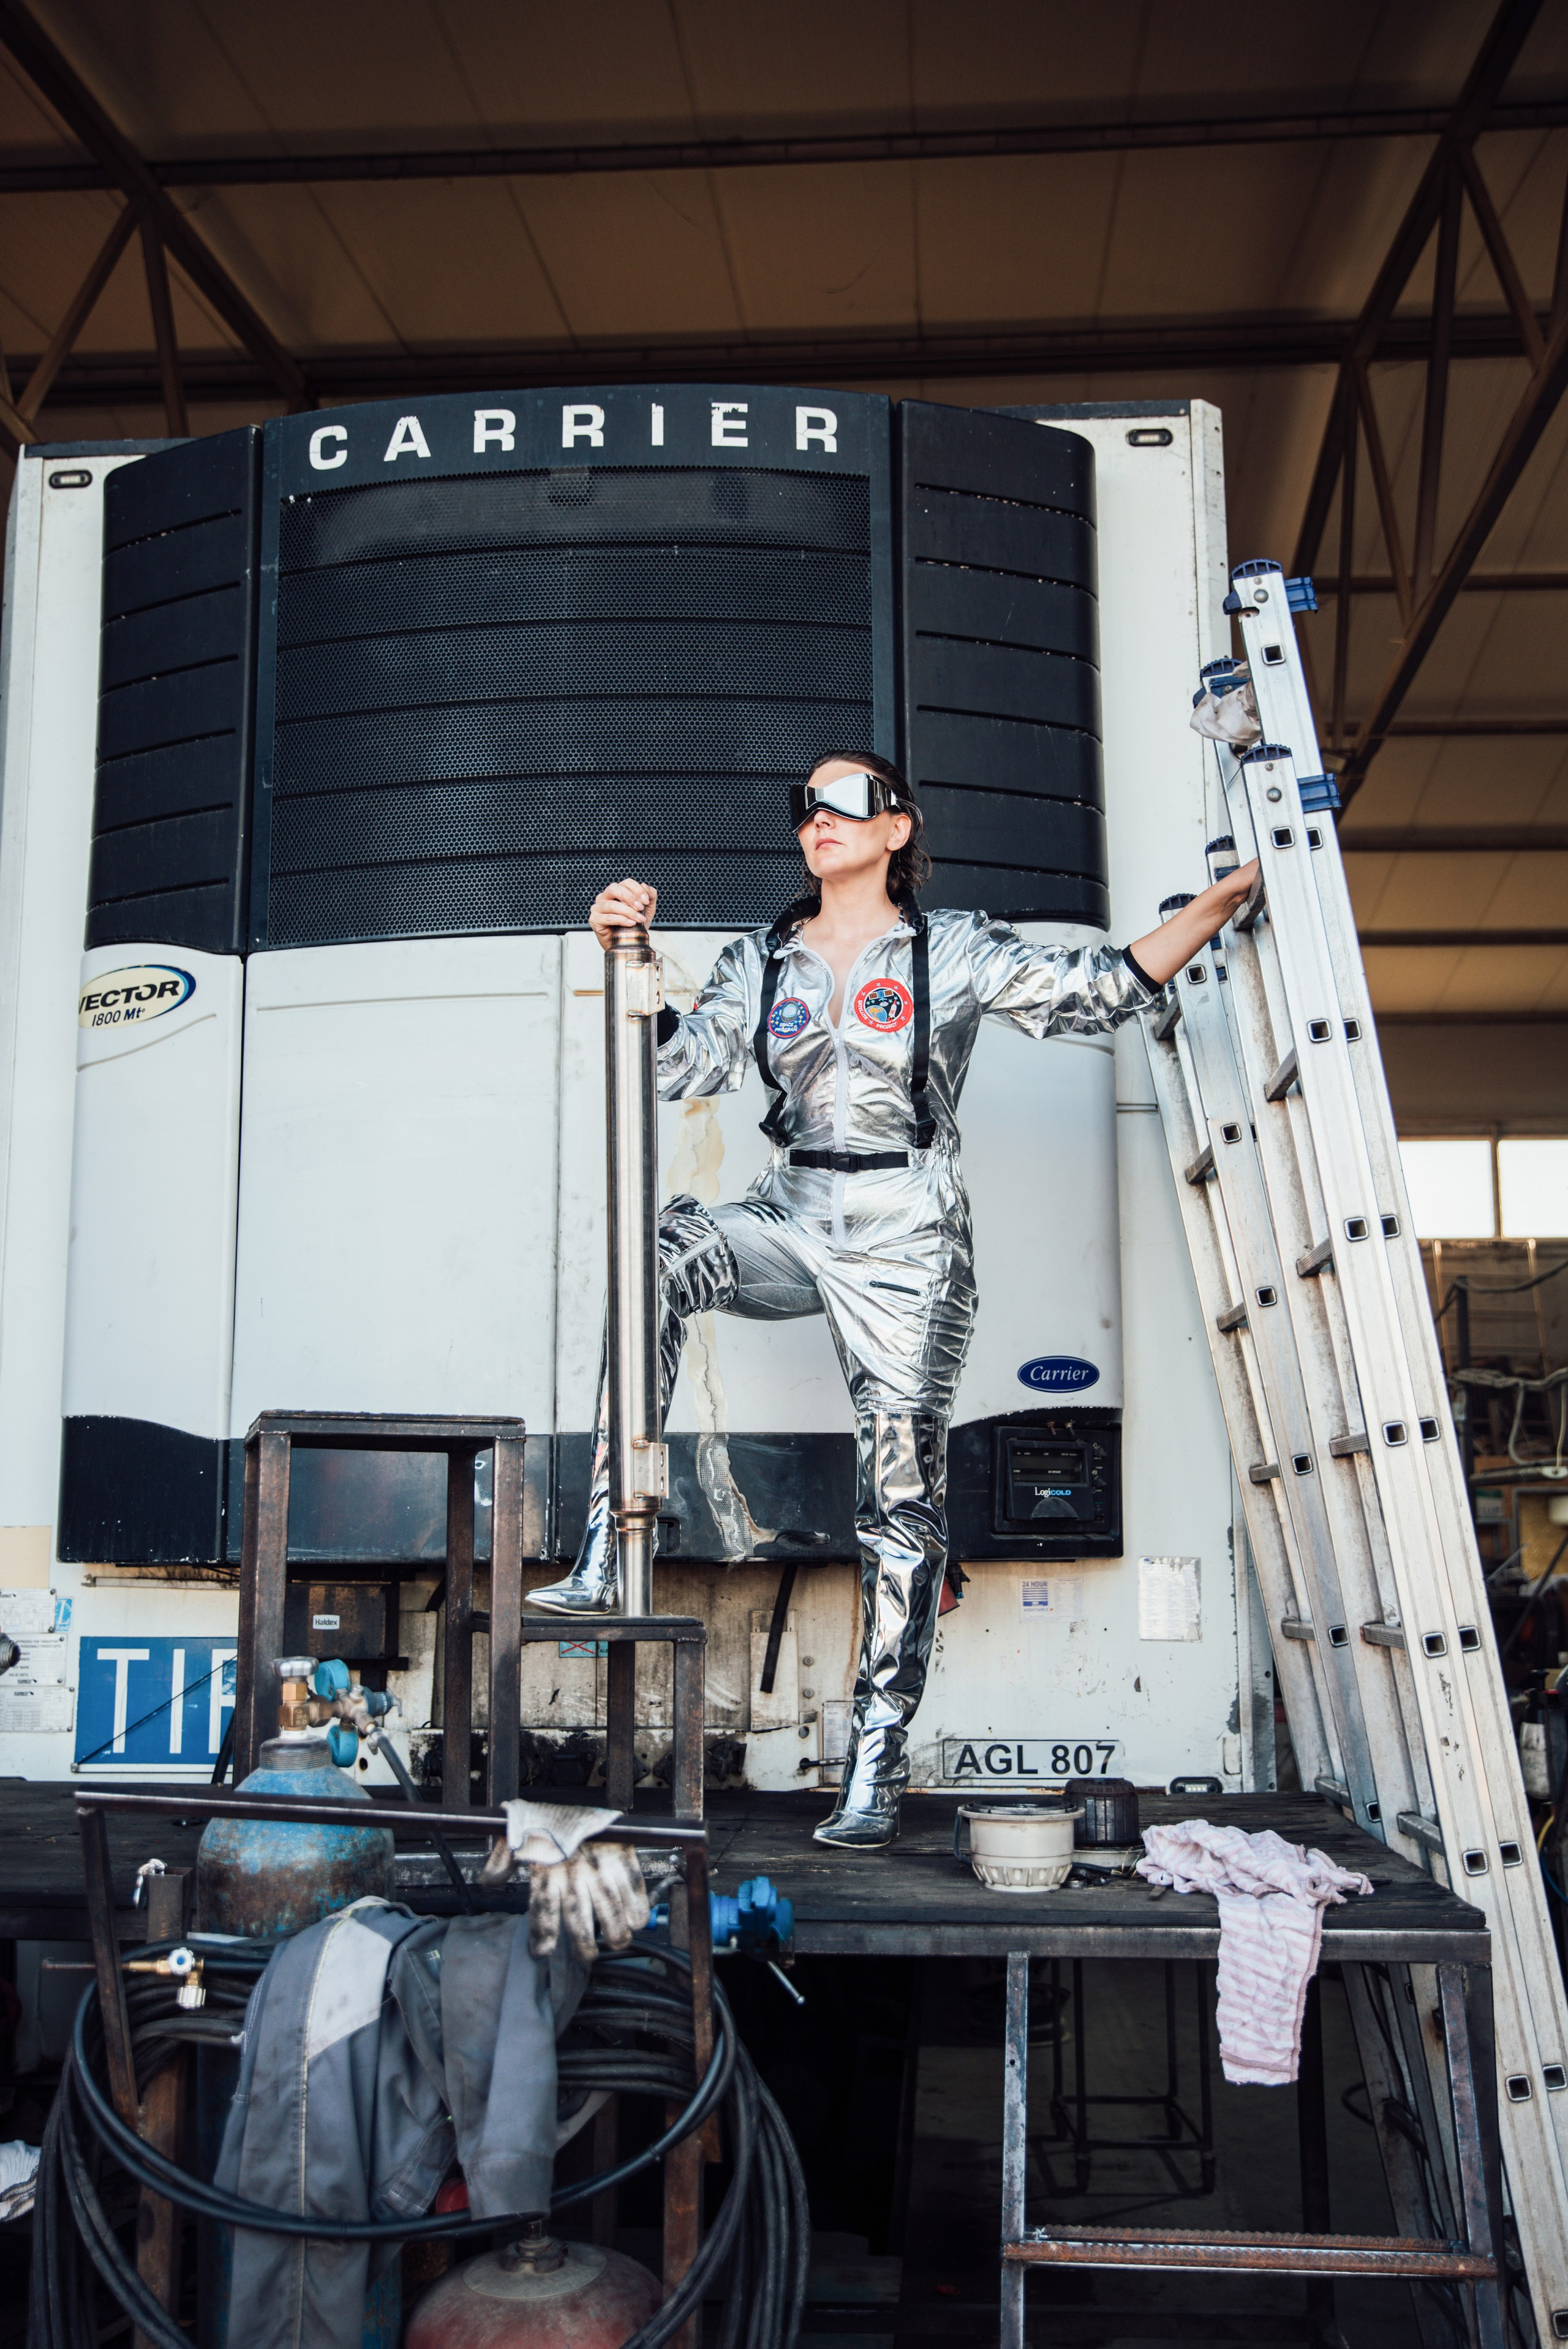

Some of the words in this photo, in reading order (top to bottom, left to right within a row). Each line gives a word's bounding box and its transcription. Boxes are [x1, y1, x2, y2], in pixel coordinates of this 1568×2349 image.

[309, 403, 838, 470] CARRIER
[92, 1010, 121, 1027] 1800
[858, 1000, 869, 1020] SATELLITE
[1030, 1366, 1089, 1381] Carrier
[954, 1744, 1038, 1774] AGL
[1050, 1744, 1116, 1775] 807
